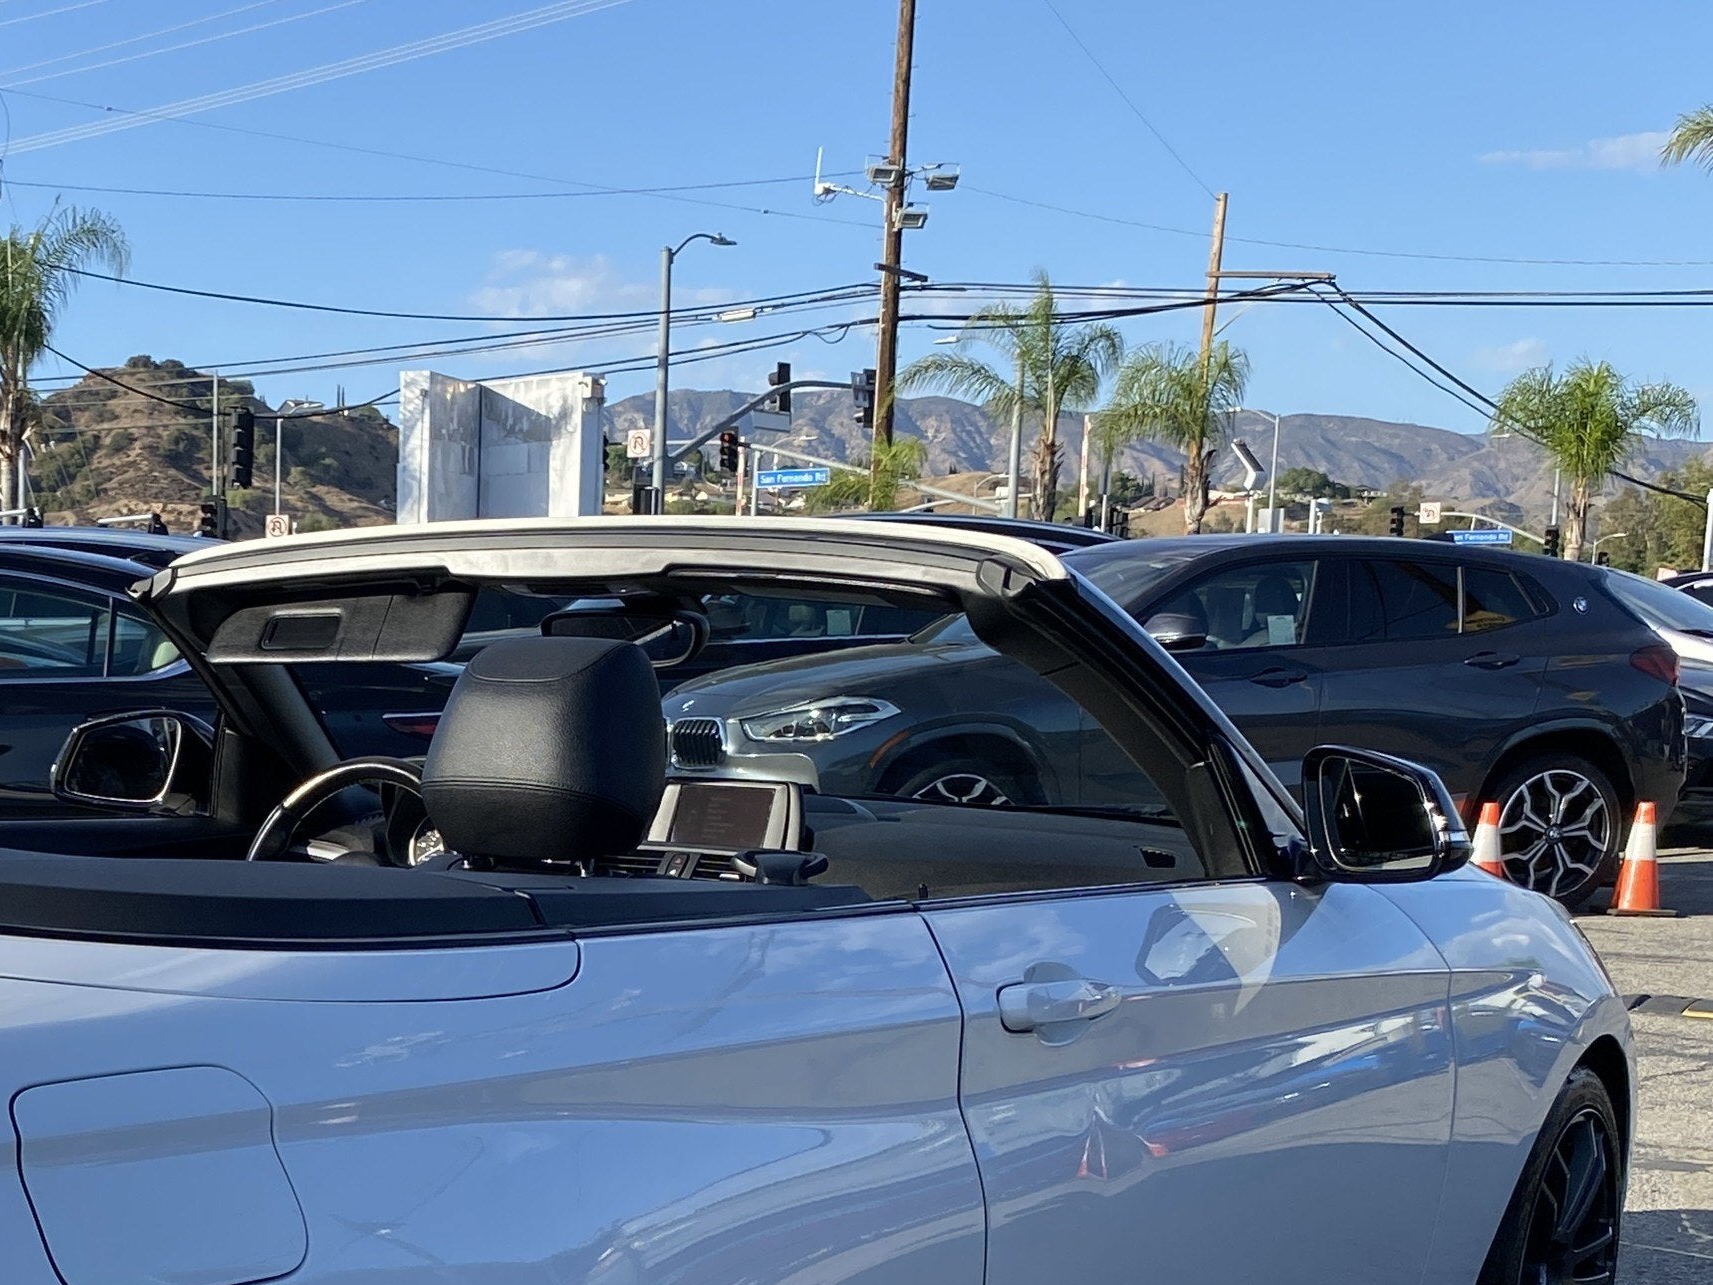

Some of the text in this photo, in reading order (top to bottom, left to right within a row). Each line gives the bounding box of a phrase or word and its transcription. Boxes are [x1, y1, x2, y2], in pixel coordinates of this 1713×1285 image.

[760, 472, 826, 484] San Fernando Rd
